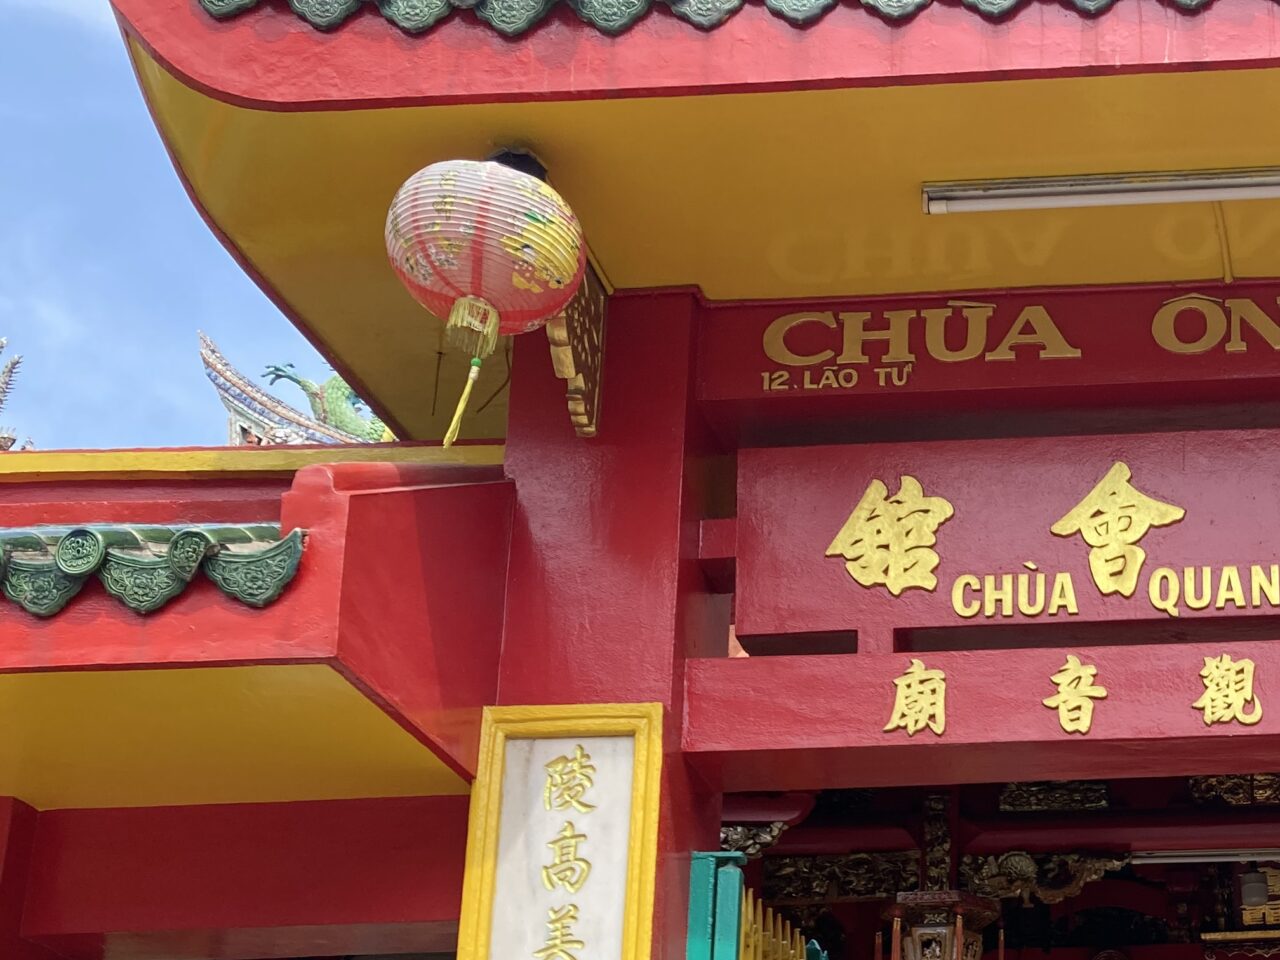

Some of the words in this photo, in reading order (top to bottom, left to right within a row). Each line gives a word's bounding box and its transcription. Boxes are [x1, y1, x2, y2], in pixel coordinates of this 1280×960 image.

[762, 299, 1083, 366] CHÙA
[803, 366, 859, 389] LÃO
[951, 560, 1079, 618] CHÙA
[1148, 564, 1280, 617] QUAN
